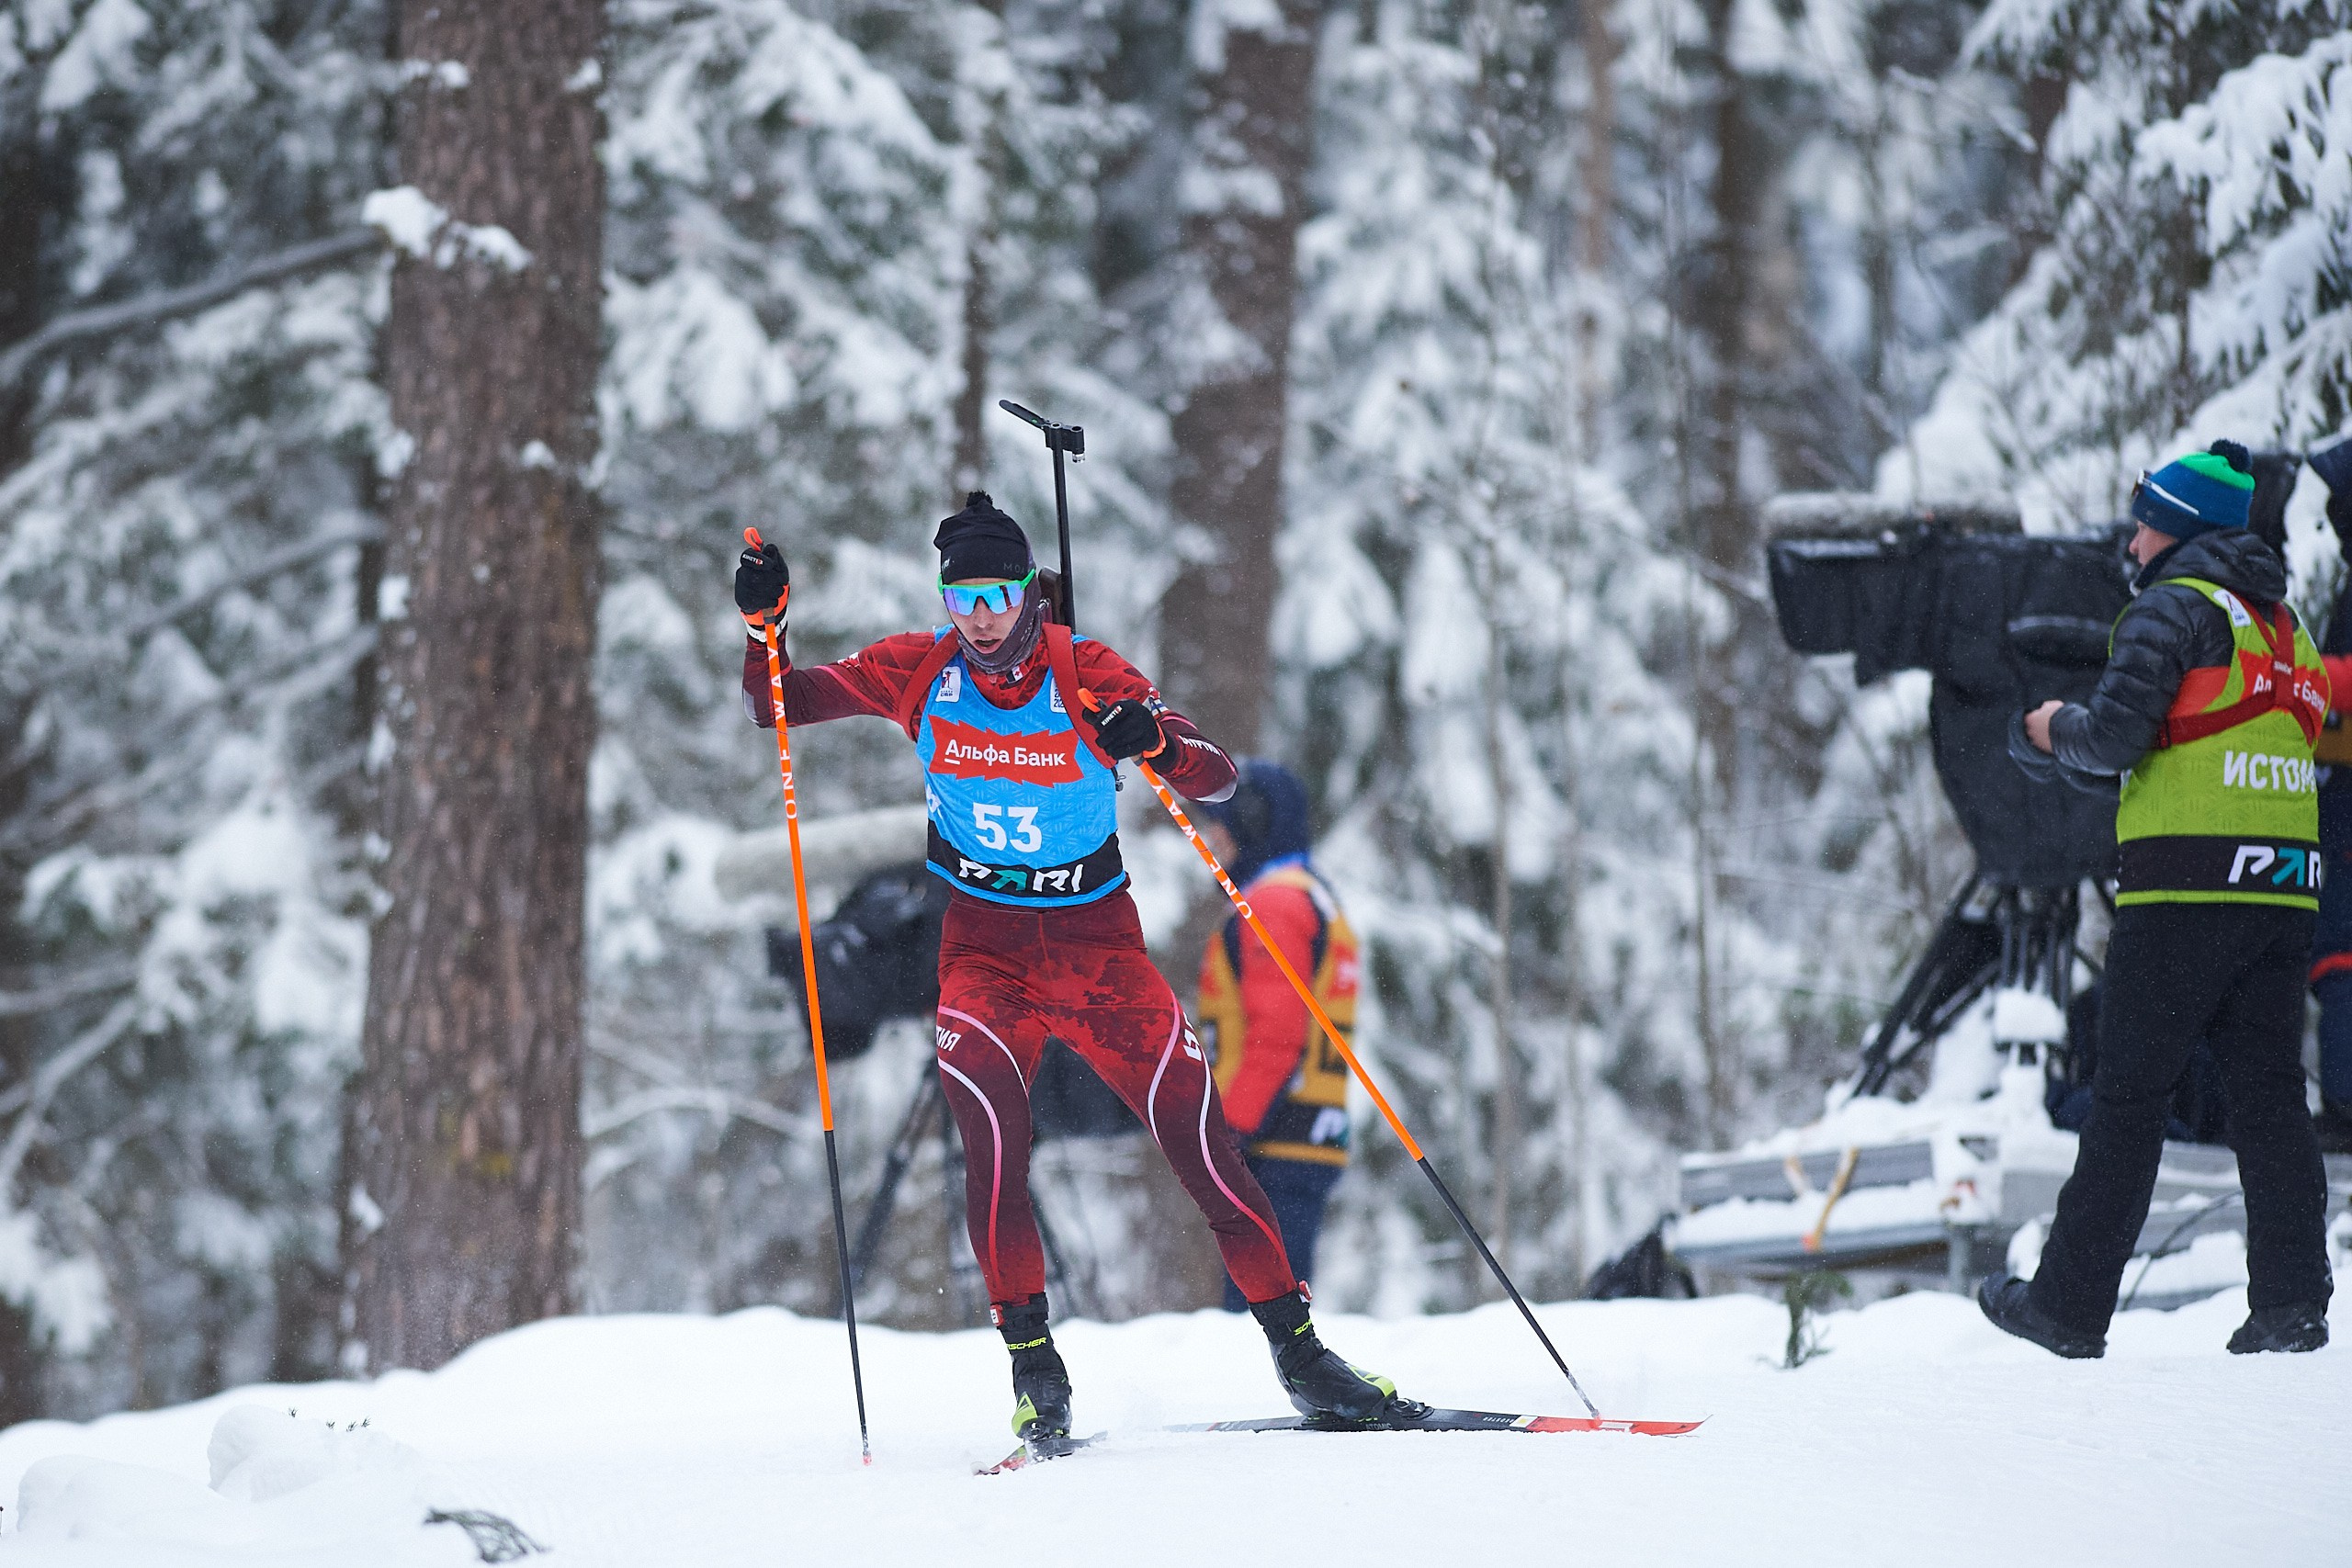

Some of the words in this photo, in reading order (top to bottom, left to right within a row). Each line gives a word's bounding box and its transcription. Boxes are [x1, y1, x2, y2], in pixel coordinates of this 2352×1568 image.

[767, 646, 786, 721] WAY
[944, 739, 1011, 766] Альфа
[1014, 747, 1067, 766] Банк
[972, 802, 1043, 853] 53
[1151, 784, 1197, 842] WAY
[958, 857, 1084, 893] PARI
[1007, 1337, 1047, 1350] ISCHER
